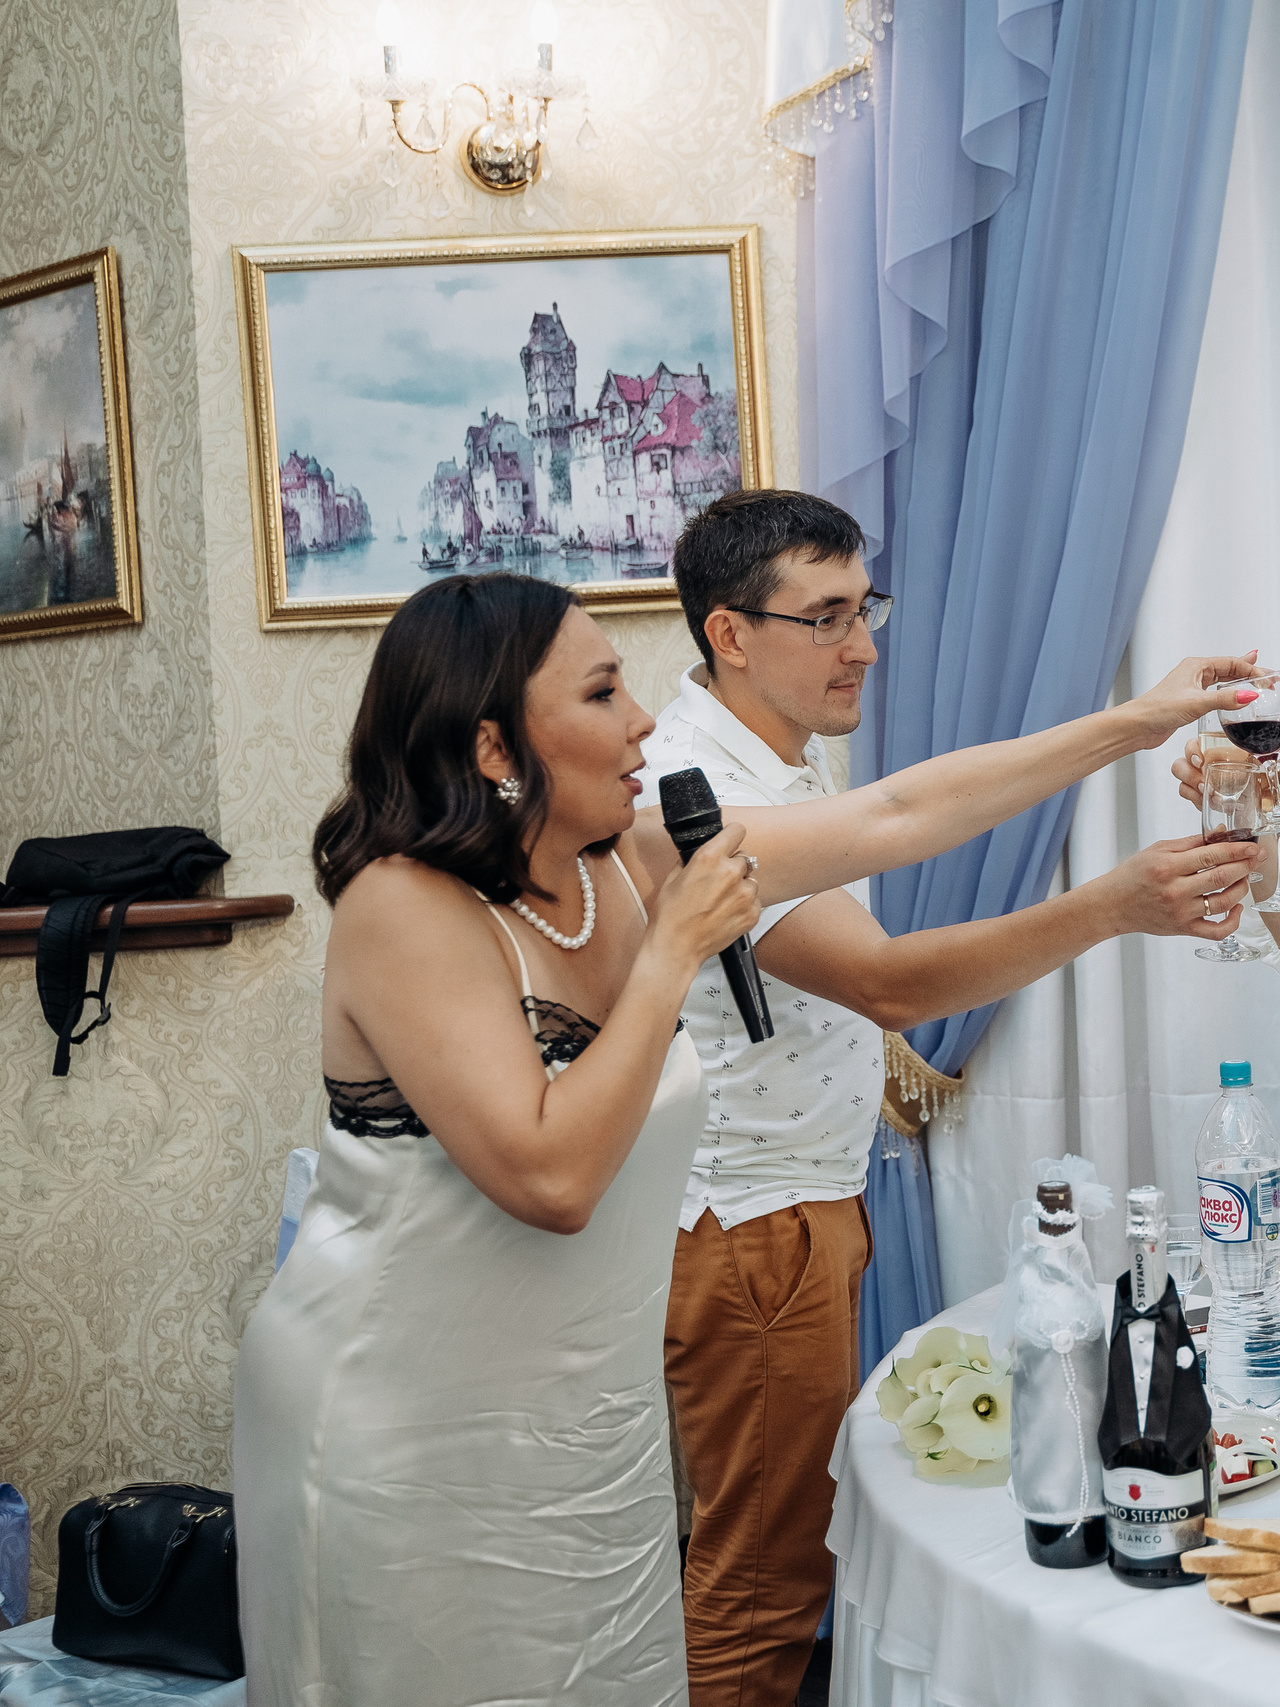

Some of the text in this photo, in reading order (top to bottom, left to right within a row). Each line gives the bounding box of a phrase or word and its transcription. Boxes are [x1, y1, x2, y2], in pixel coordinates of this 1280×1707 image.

[1135, 1253, 1146, 1299] STEFANO
[1130, 1507, 1189, 1523] STEFANO
[1117, 1531, 1162, 1544] BIANCO
